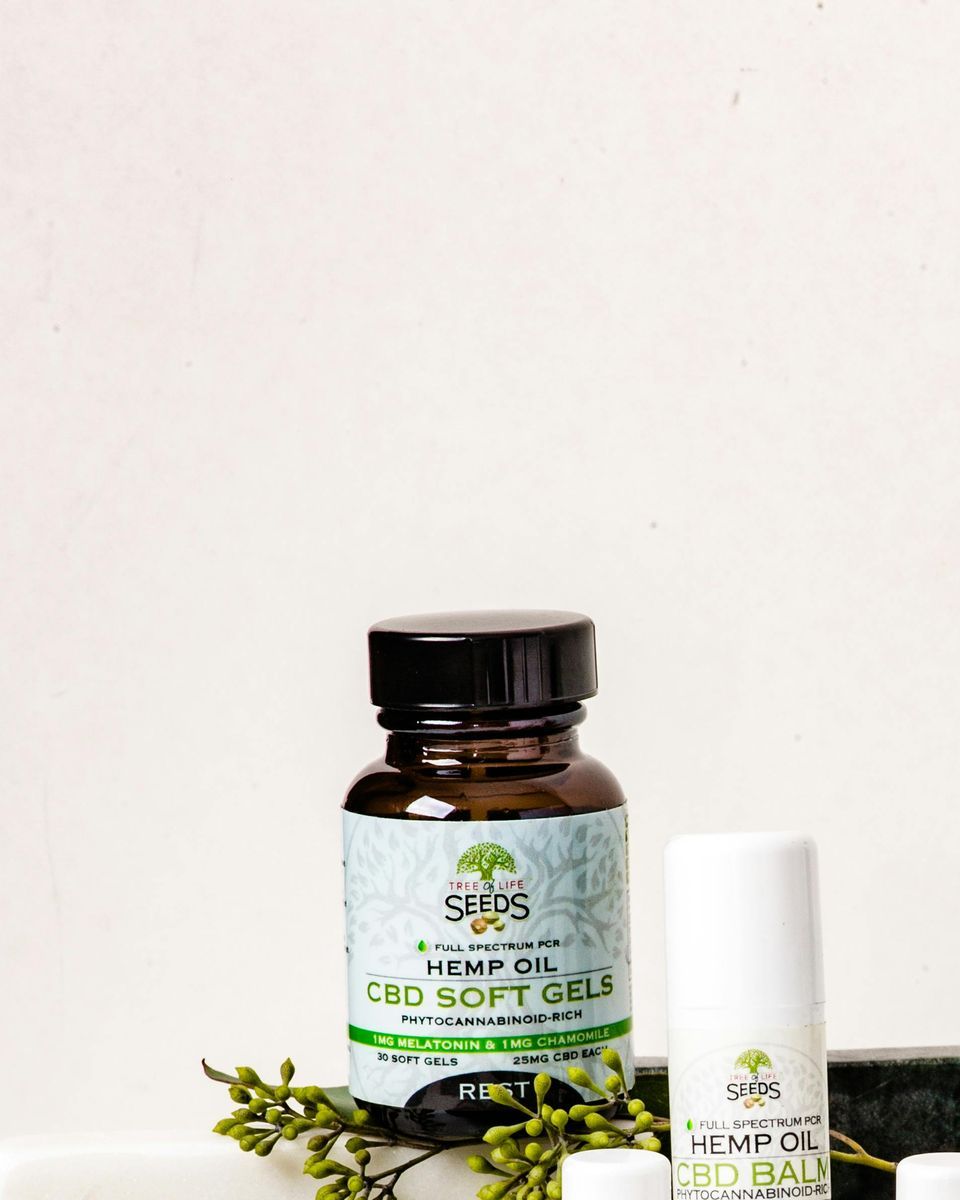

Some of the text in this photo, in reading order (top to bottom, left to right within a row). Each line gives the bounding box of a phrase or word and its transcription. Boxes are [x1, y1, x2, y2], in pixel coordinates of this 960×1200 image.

[450, 882, 478, 890] TREE
[499, 880, 524, 889] LIFE
[445, 893, 529, 921] SEEDS
[435, 940, 560, 952] FULL SPECTRUM PCR
[427, 957, 557, 976] HEMP OIL
[367, 975, 613, 1008] CBD SOFT GELS
[402, 1010, 582, 1026] PHYTOCANNABINOID-RICH
[374, 1034, 394, 1047] 1MG
[398, 1038, 480, 1050] MELATONIN
[486, 1040, 495, 1049] &
[537, 1028, 609, 1047] CHAMOMILE
[377, 1052, 458, 1066] 30 SOFT GELS
[513, 1046, 608, 1064] 25MG CBD EAC
[727, 1082, 780, 1100] SEEDS
[700, 1115, 821, 1129] FULL SPECTRUM PCR
[692, 1131, 818, 1154] HEMP OIL
[677, 1158, 828, 1187] CBD BALM
